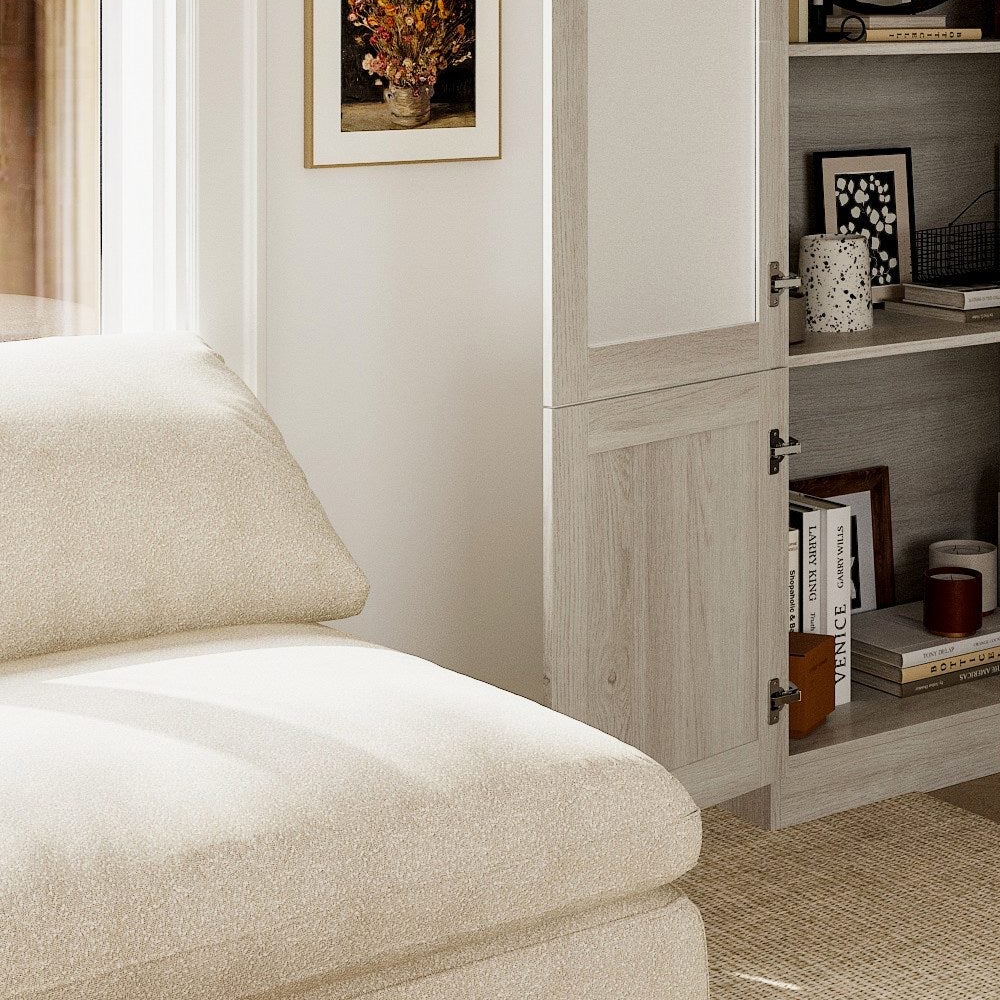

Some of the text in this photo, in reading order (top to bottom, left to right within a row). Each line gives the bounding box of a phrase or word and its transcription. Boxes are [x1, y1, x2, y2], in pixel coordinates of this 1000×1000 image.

[808, 525, 817, 566] LARRY
[808, 569, 817, 601] KING
[834, 604, 847, 684] VENICE
[923, 651, 938, 659] TONY
[959, 667, 990, 681] AMERICAS
